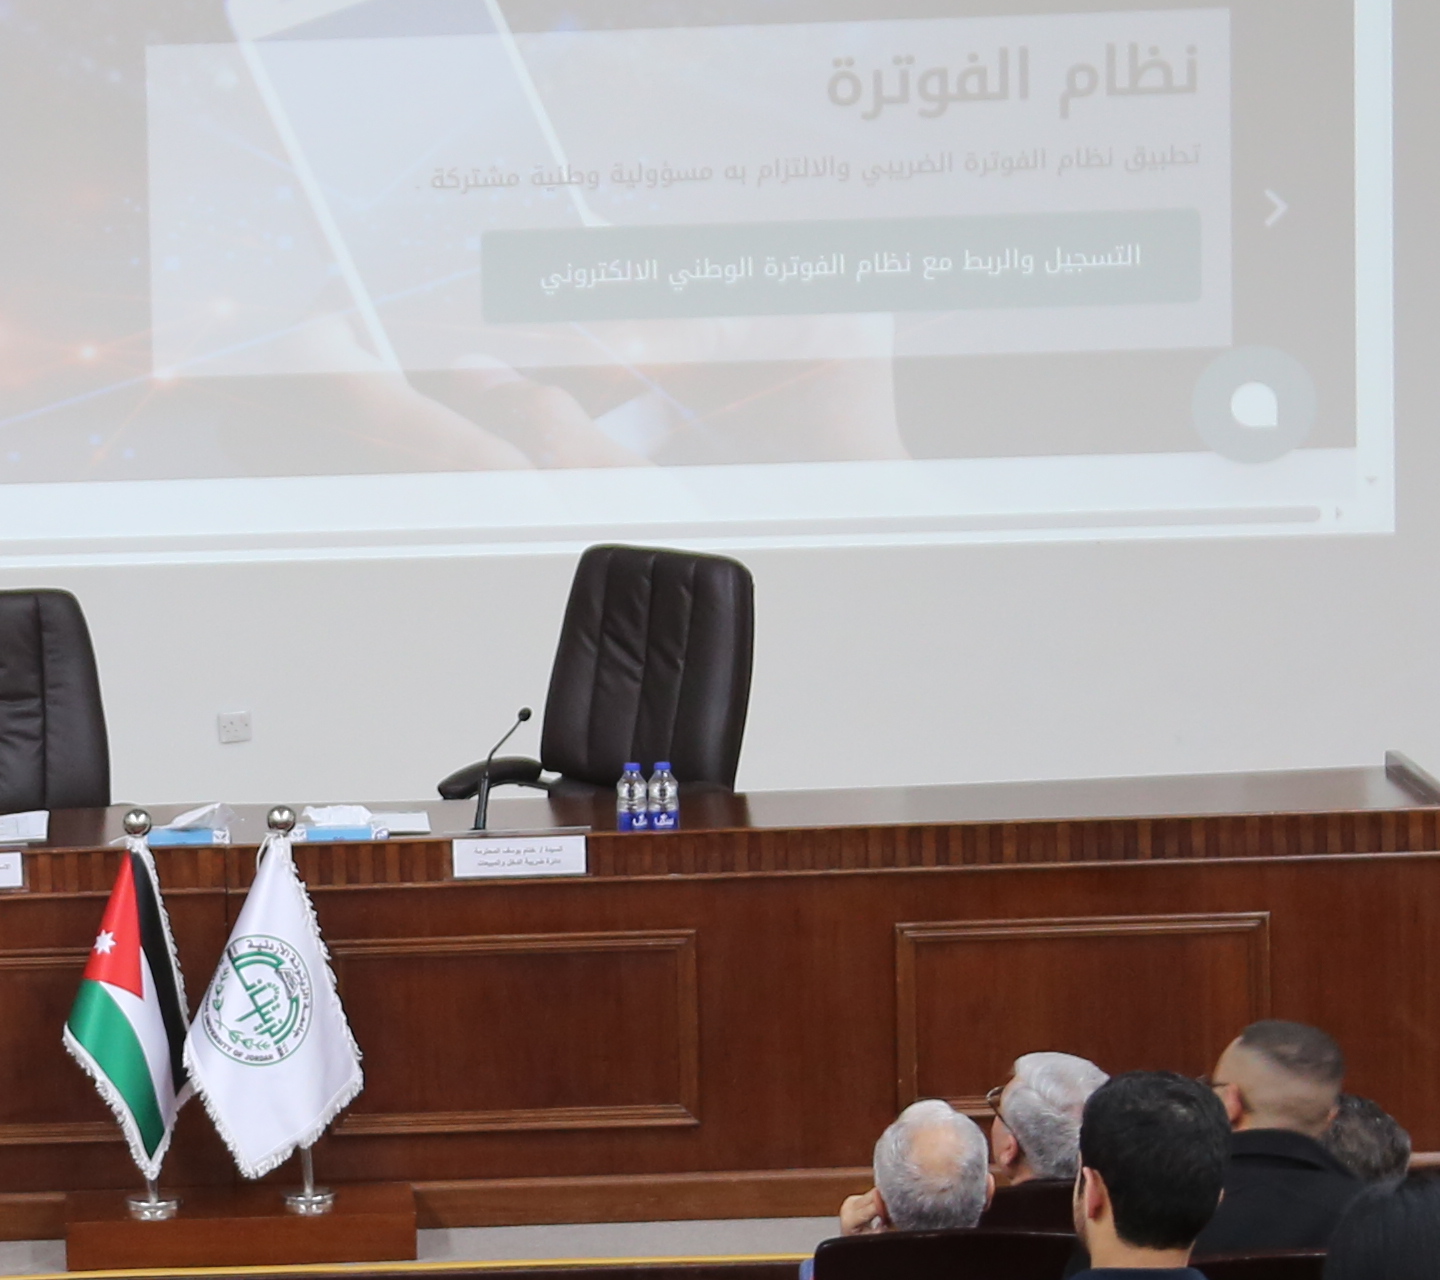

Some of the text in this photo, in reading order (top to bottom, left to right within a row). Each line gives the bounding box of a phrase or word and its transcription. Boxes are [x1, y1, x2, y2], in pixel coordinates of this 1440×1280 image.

[826, 41, 1200, 121] نظام الفوترة
[723, 162, 747, 185] به
[757, 153, 851, 188] والالتزام
[861, 151, 954, 187] الضريبي
[964, 148, 1047, 177] الفوترة
[1056, 145, 1115, 177] نظام
[1123, 141, 1202, 175] تطبيق
[429, 166, 520, 195] مشتركة
[530, 163, 600, 192] وطنية
[609, 161, 714, 188] مسؤولية
[540, 243, 1142, 294] التسجيل والربط مع نظام الفوترة الوطني الالكتروني
